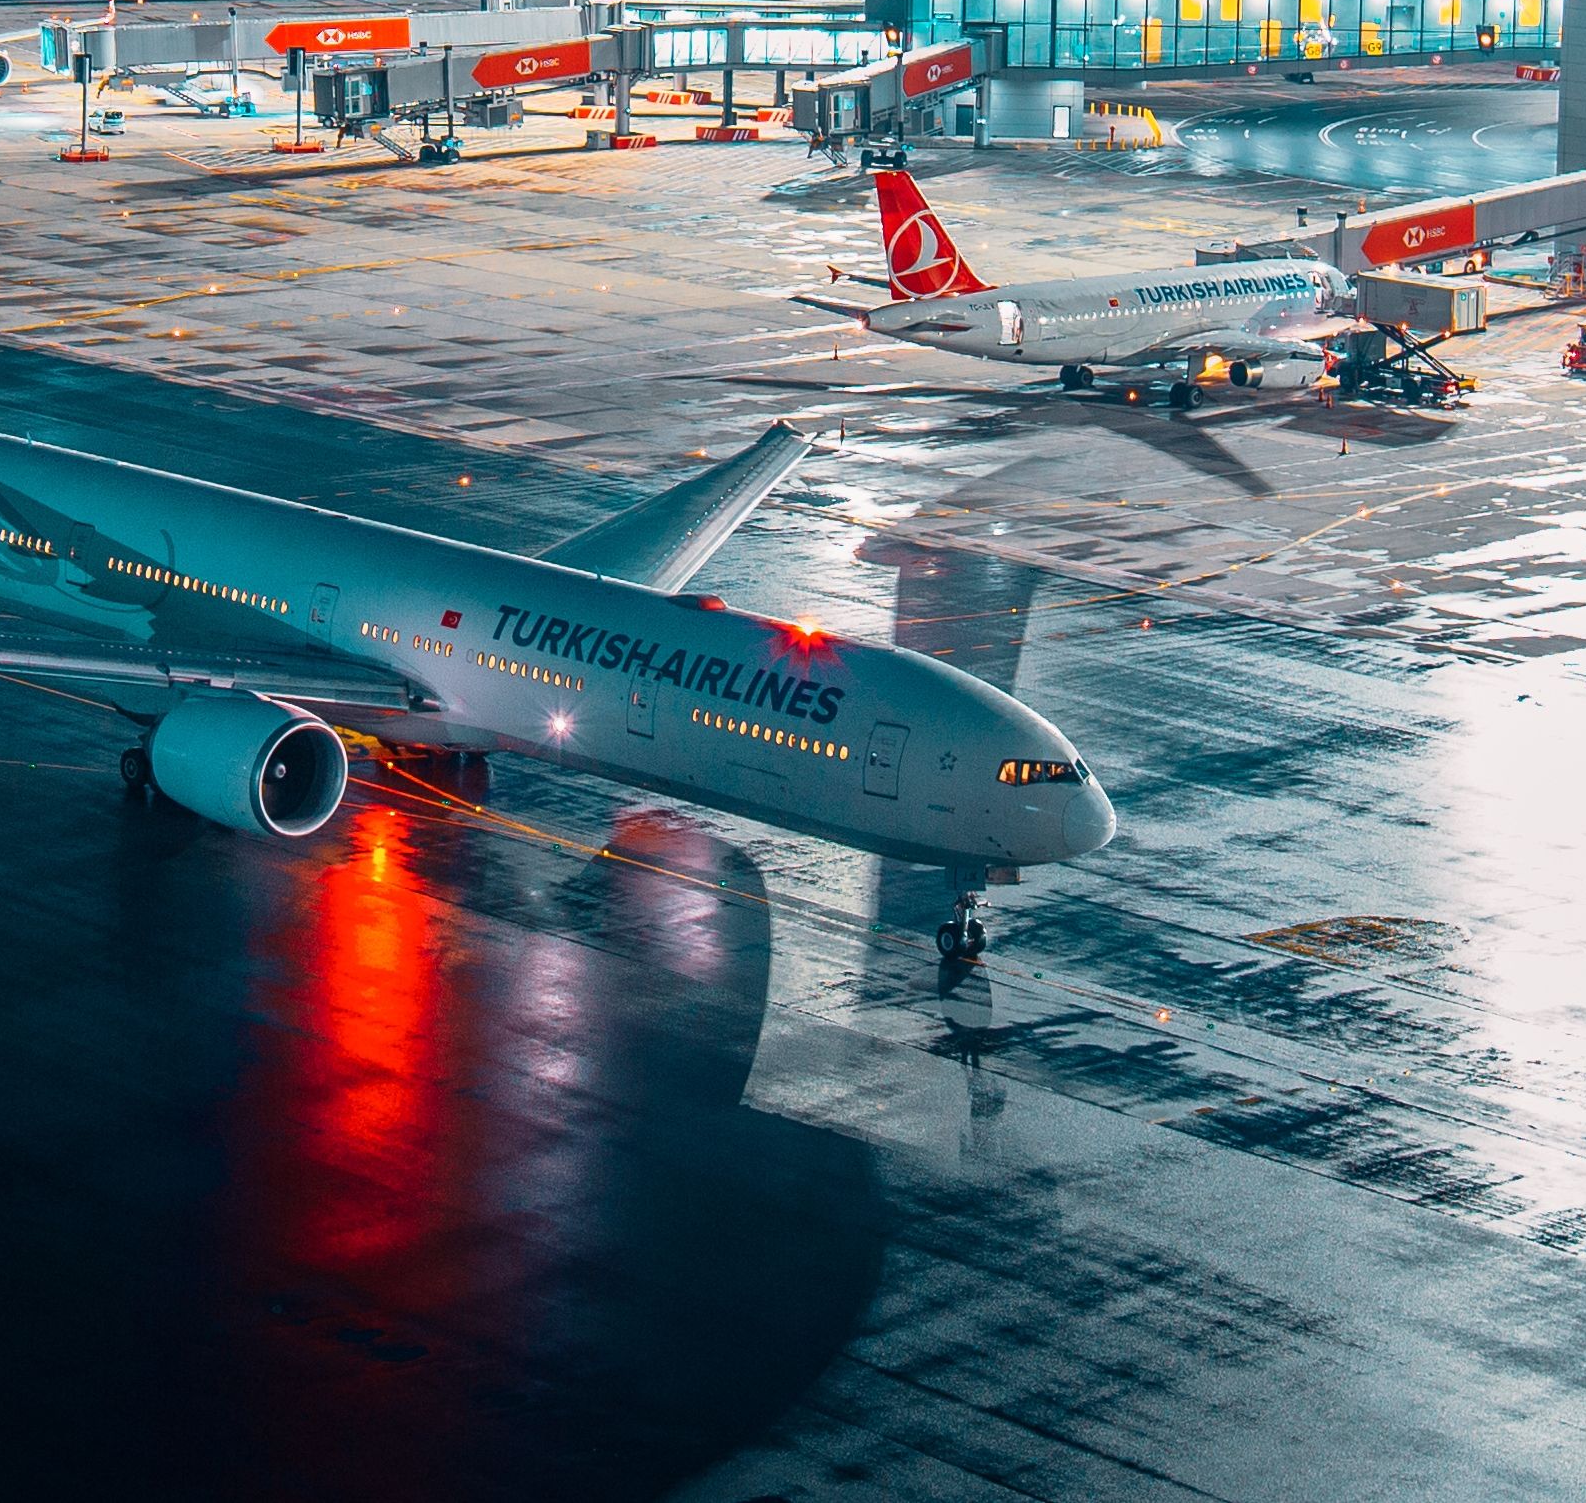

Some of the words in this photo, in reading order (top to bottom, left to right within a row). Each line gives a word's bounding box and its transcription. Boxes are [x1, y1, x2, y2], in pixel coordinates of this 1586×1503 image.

[346, 29, 373, 41] HSBC
[1134, 281, 1221, 305] TURKISH
[1223, 273, 1308, 297] AIRLINES
[491, 604, 662, 679] TURKISH
[651, 648, 847, 725] AIRLINES
